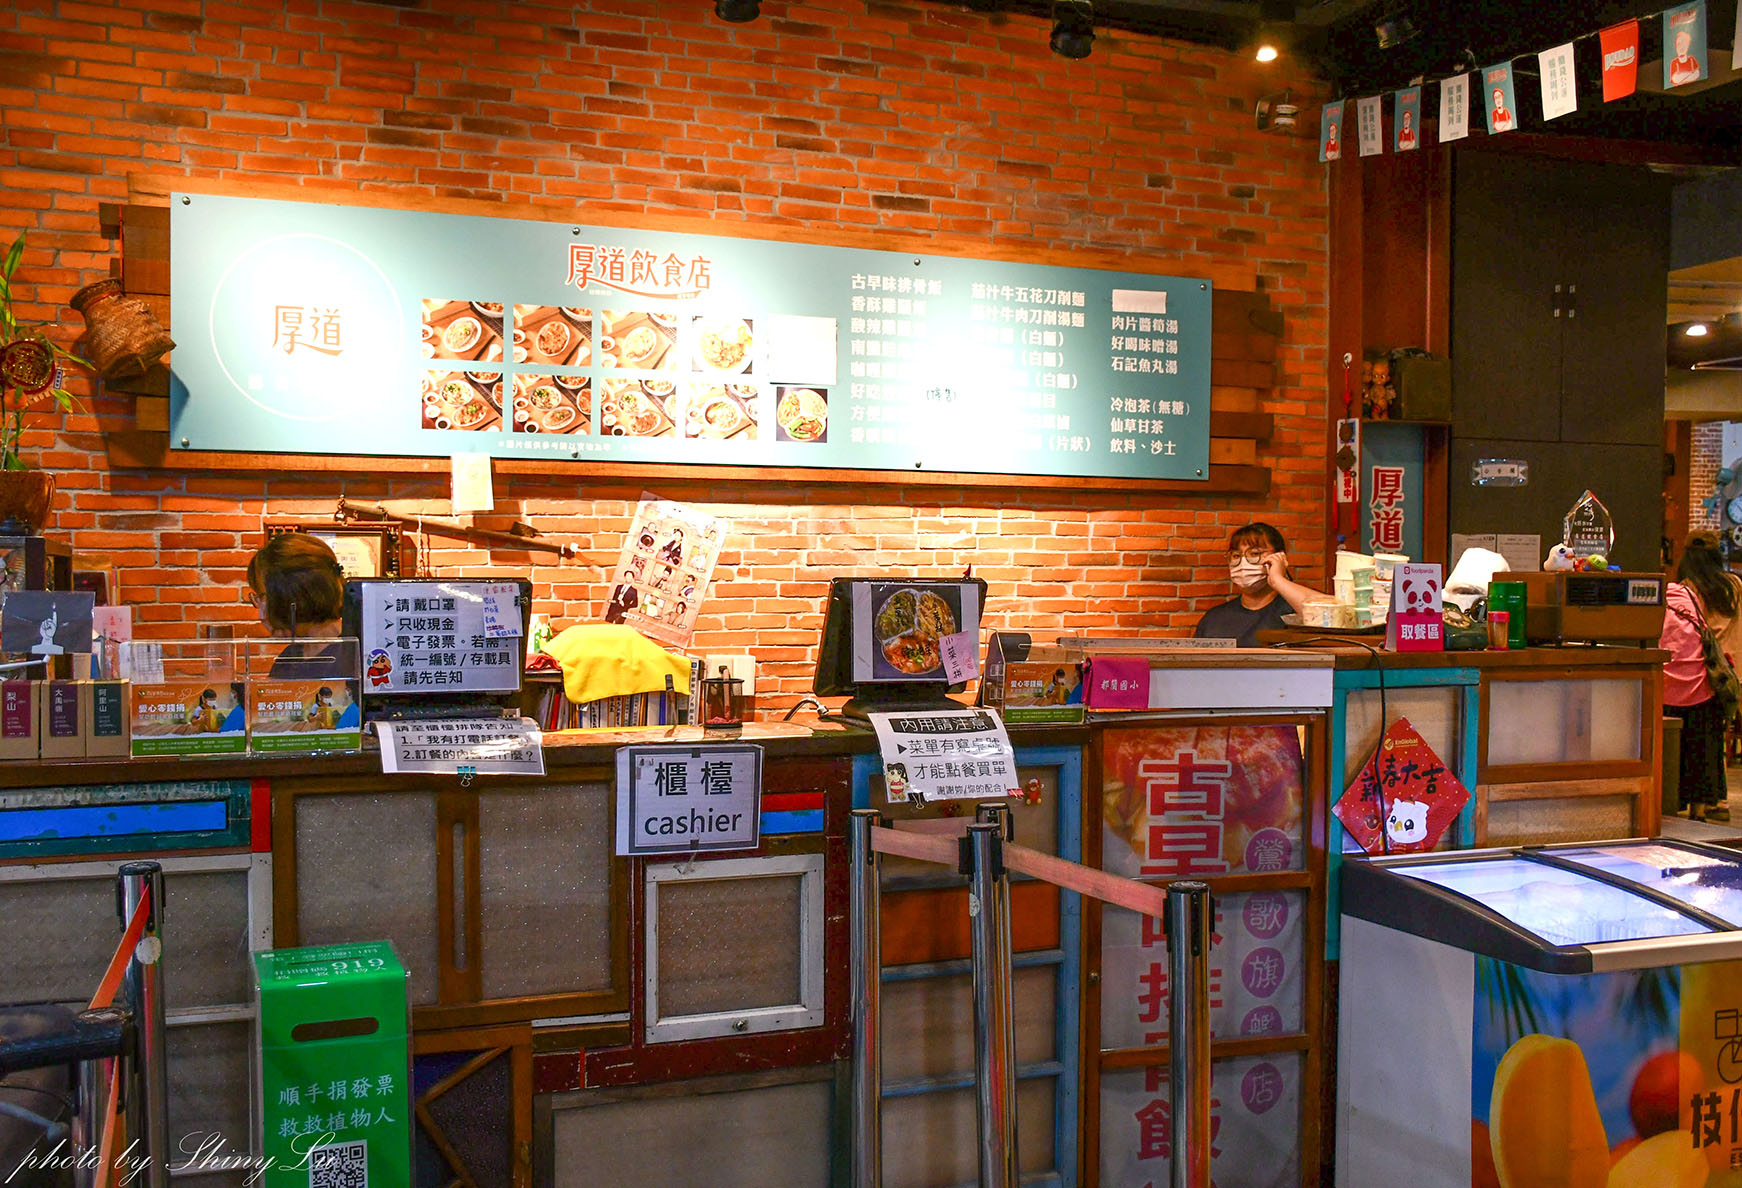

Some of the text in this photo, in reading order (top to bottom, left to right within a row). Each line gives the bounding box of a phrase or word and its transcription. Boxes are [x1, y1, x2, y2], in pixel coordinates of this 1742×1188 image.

[565, 243, 711, 290] 厚道飲食店
[271, 304, 343, 357] 厚道
[1111, 356, 1179, 375] 石記魚丸湯
[1110, 396, 1191, 416] 冷泡茶(無糖)
[1110, 417, 1164, 435] 仙草甘茶
[1110, 438, 1177, 456] 飲料、沙士
[1369, 466, 1404, 554] 厚道
[396, 598, 456, 613] 請戴口罩
[398, 616, 456, 632] 只收現金
[1400, 623, 1440, 640] 取餐區
[403, 670, 464, 685] 請先告知
[138, 703, 186, 713] 愛心零錢捐
[257, 701, 303, 711] 愛心零錢捐
[899, 717, 989, 732] 內用請注意
[655, 761, 733, 796] 櫃檯
[913, 760, 1008, 780] 才能點餐買單
[644, 807, 742, 836] cashier
[279, 1074, 395, 1107] 順手捐發票
[278, 1105, 396, 1138] 救救植物人
[1690, 1089, 1742, 1149] 枝
